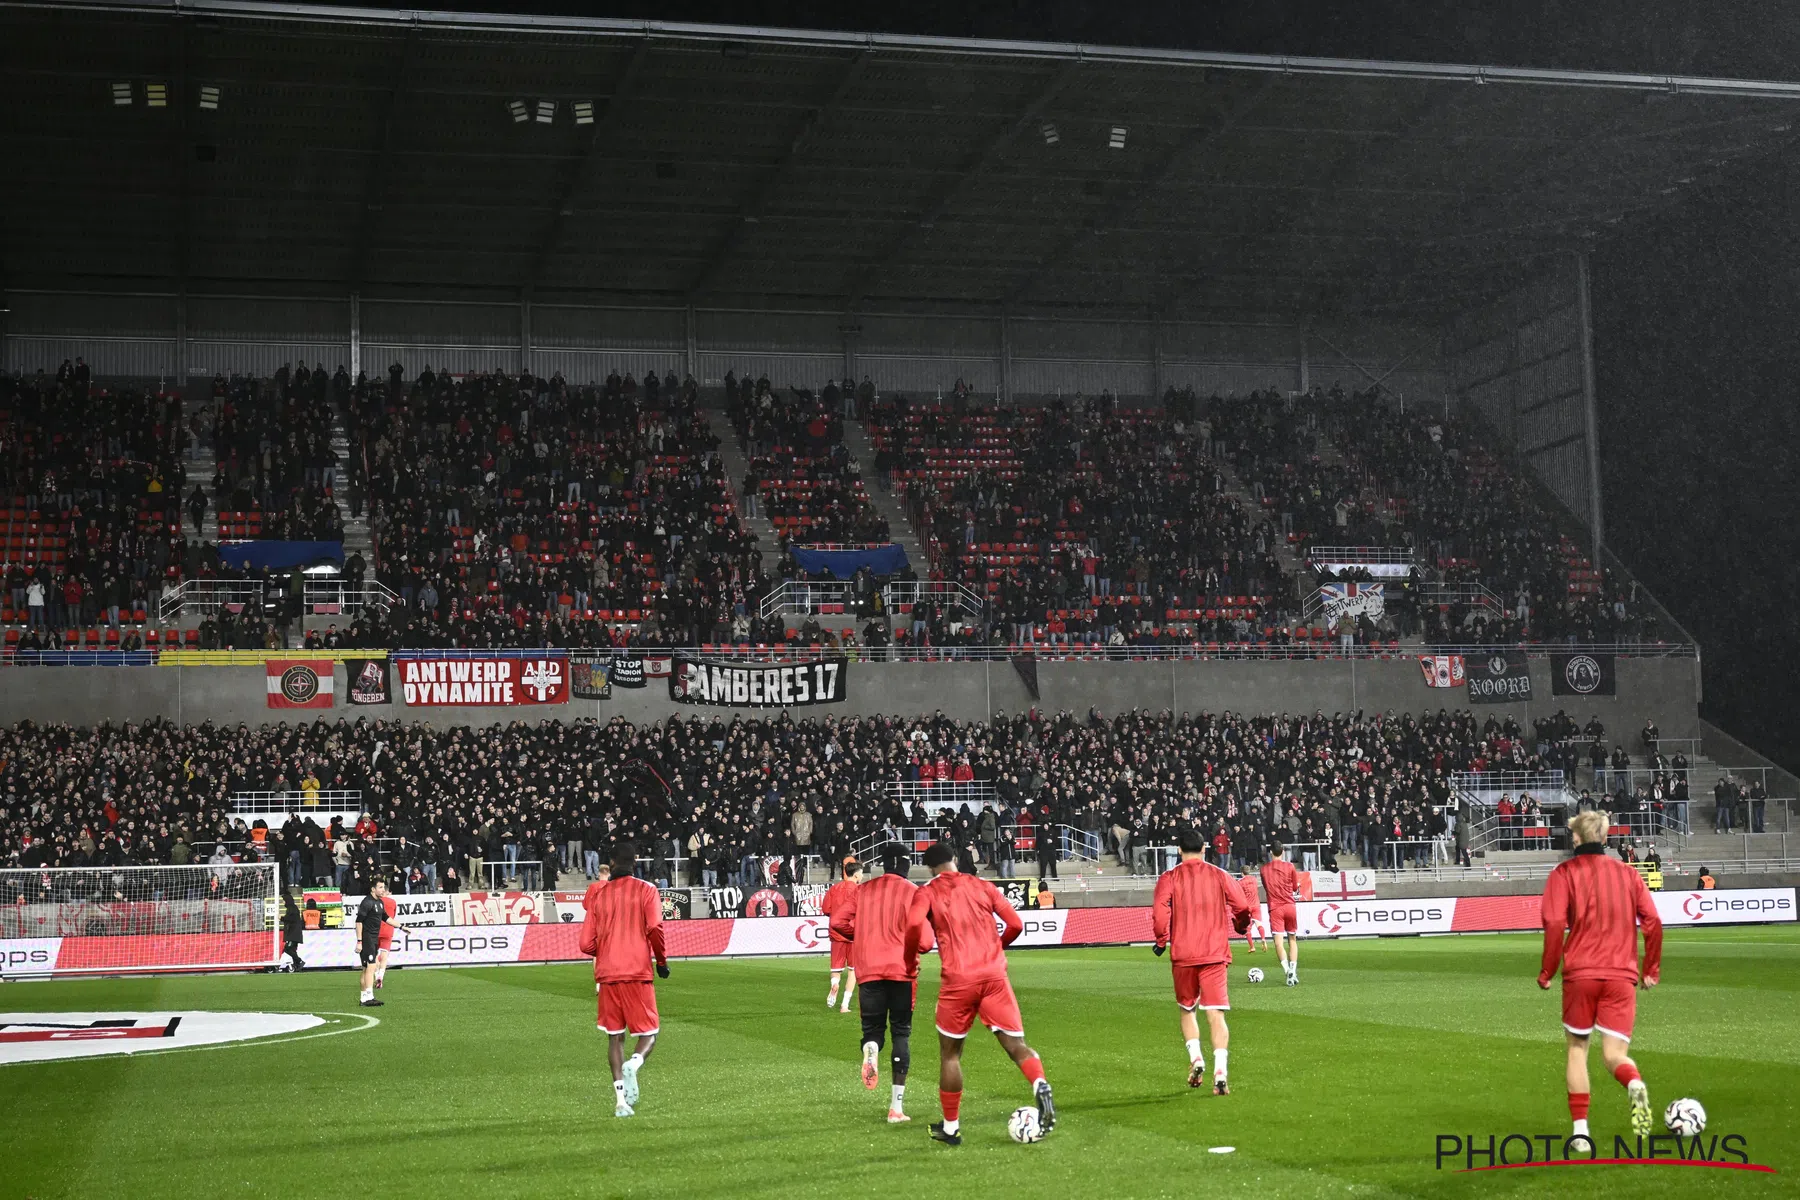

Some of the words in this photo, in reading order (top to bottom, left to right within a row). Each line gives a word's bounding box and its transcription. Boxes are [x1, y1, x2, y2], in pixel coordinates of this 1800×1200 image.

[406, 662, 511, 683] ANTWERP
[524, 663, 534, 676] A
[549, 664, 560, 676] D
[615, 660, 641, 668] STOP
[528, 687, 533, 695] 1
[548, 687, 556, 695] 4
[697, 665, 809, 703] AMBERES
[814, 663, 839, 700] 17
[1469, 676, 1531, 698] NOORD
[403, 682, 514, 704] DYNAMITE
[462, 897, 535, 925] RAFC
[1699, 897, 1791, 913] cheops
[1337, 907, 1442, 924] cheops
